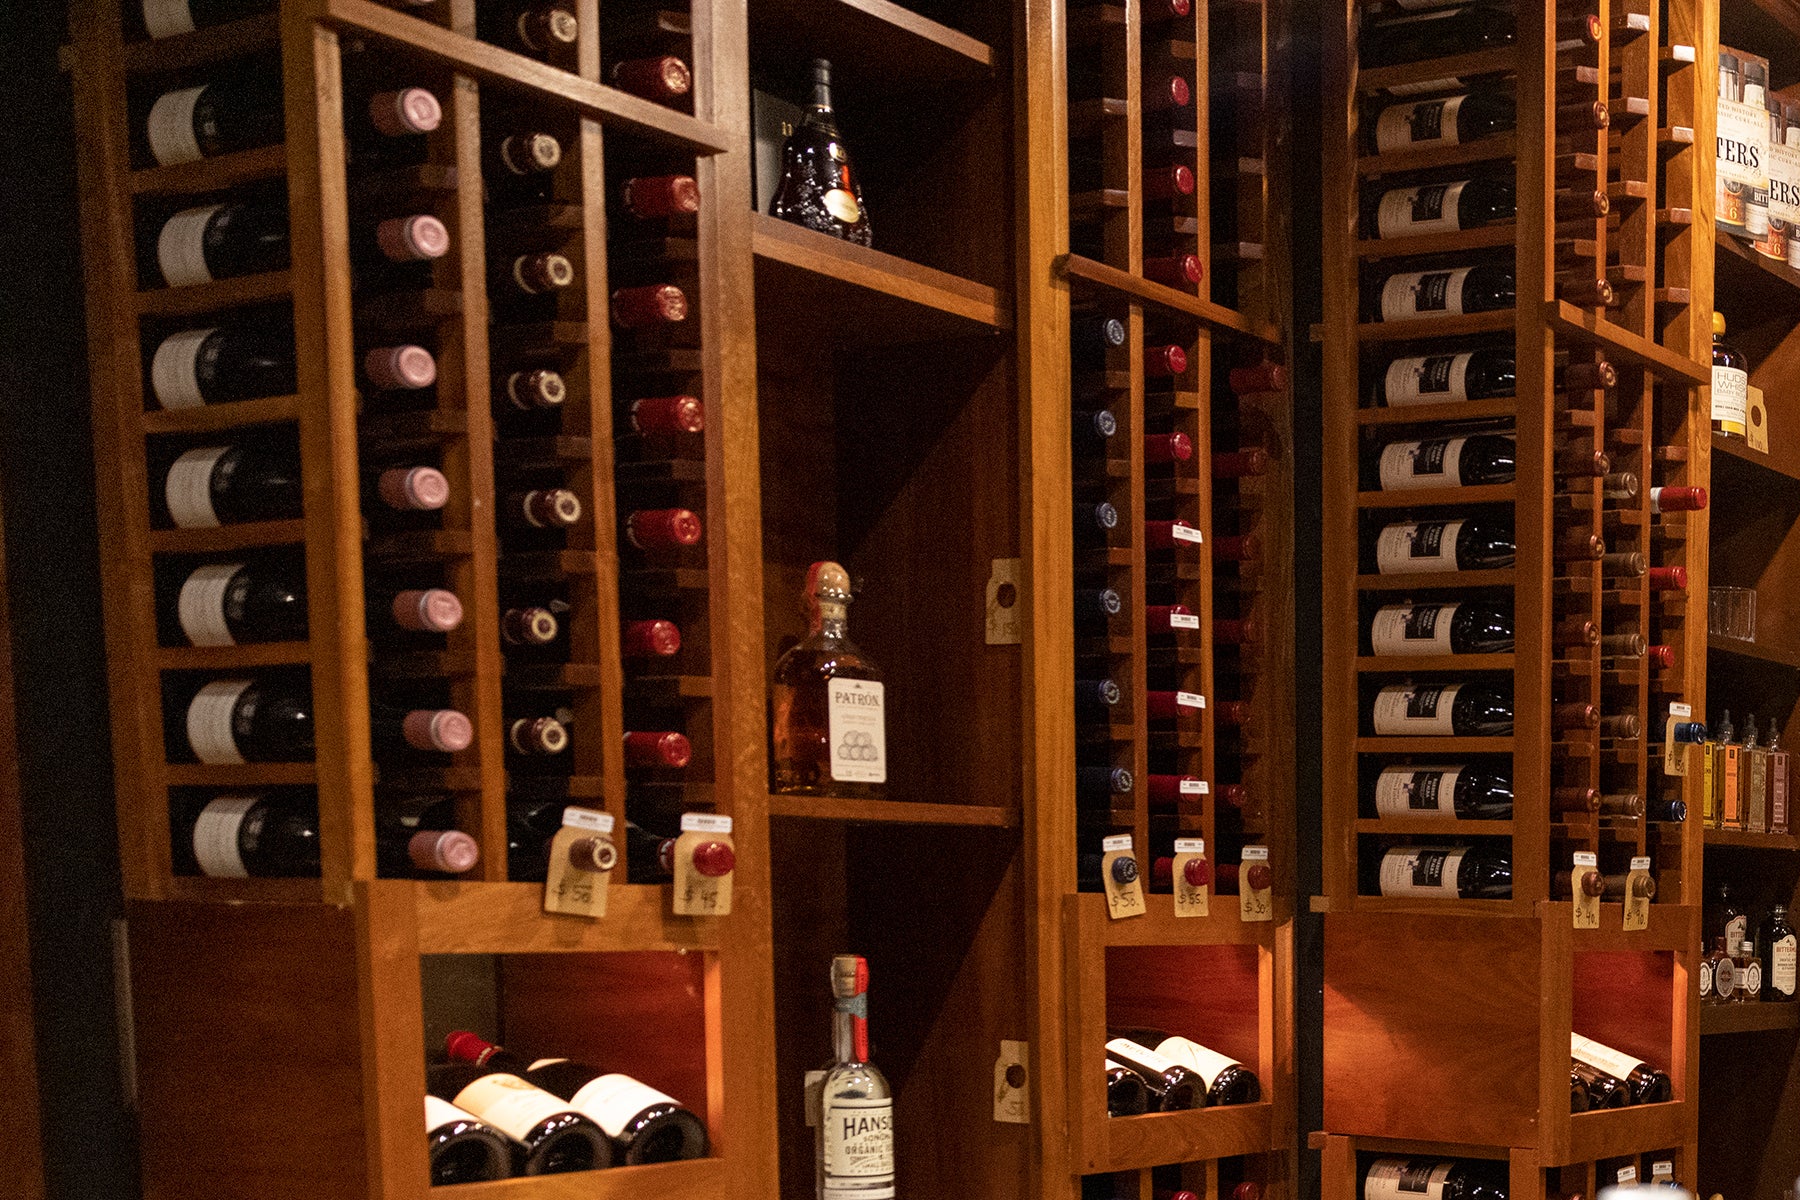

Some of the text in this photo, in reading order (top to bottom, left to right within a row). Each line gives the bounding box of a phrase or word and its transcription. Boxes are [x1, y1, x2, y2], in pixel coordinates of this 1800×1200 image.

[1769, 178, 1800, 206] ERS
[1729, 207, 1737, 219] 6
[1773, 243, 1781, 255] 6
[845, 1145, 883, 1155] ORGANIC
